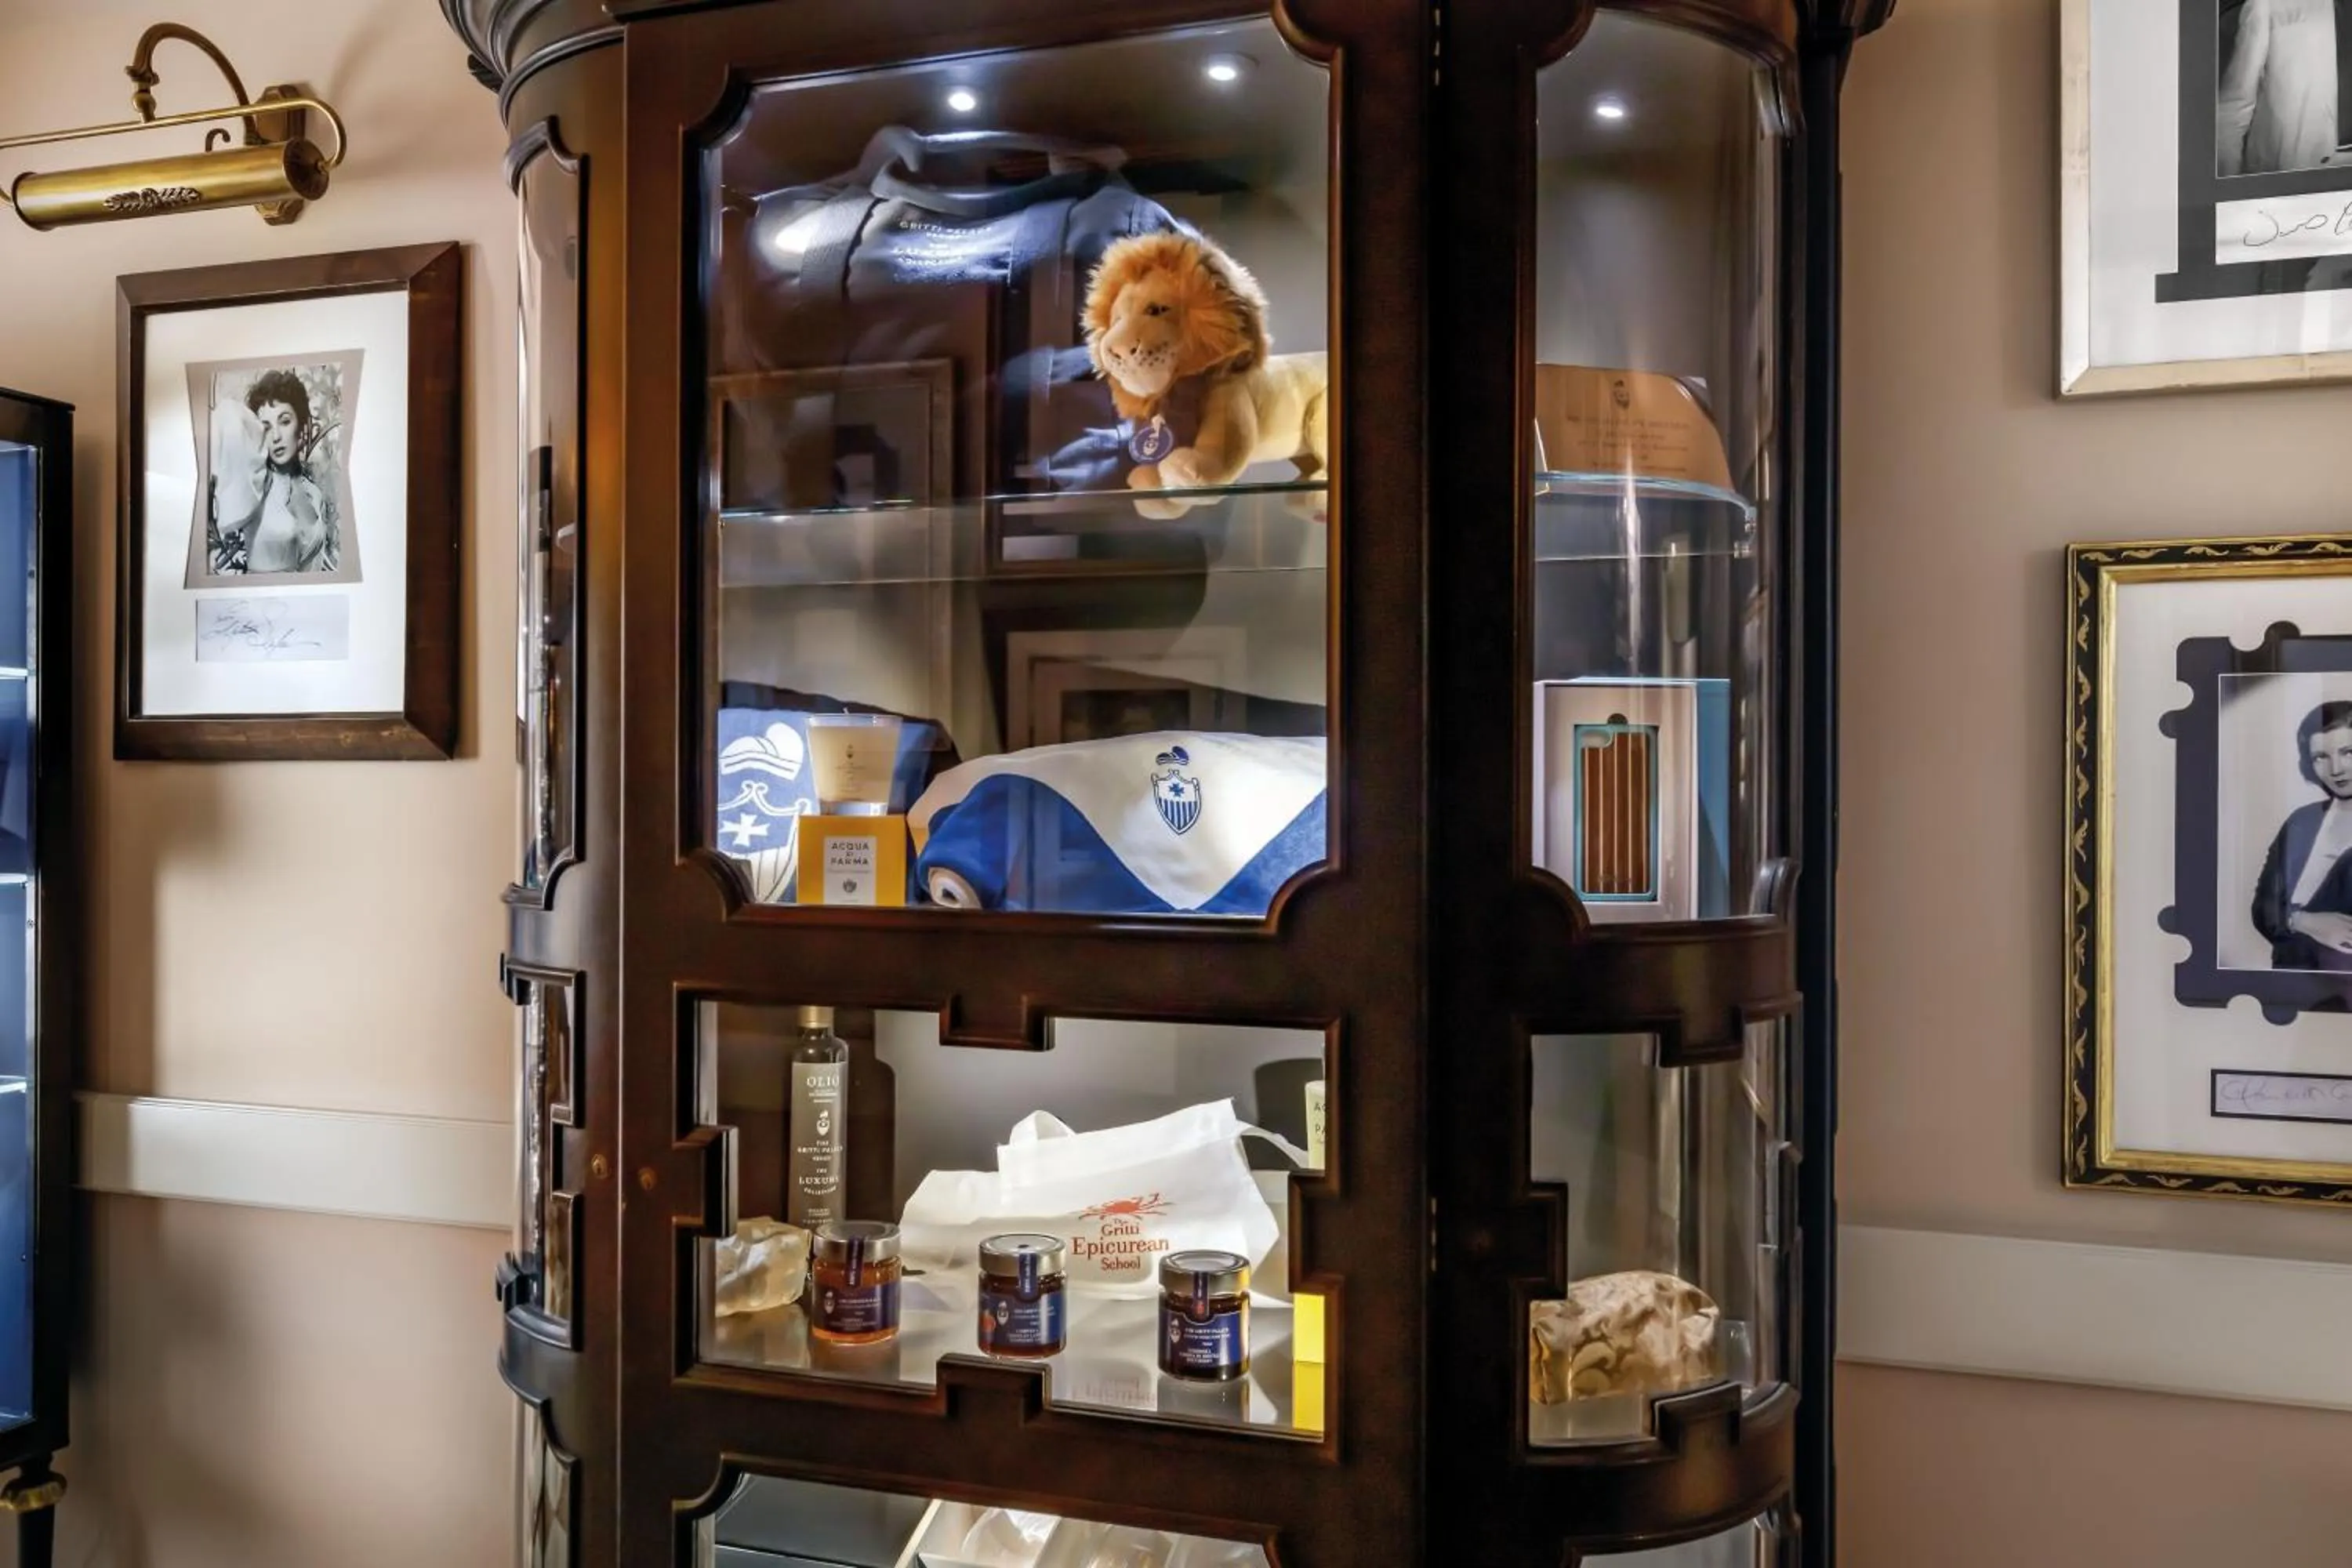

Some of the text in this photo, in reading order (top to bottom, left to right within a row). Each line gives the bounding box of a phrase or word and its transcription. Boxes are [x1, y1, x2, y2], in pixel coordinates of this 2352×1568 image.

[806, 1076, 840, 1088] OLIO
[1101, 1223, 1140, 1236] Gritti
[1071, 1236, 1170, 1261] Epicurean
[1101, 1256, 1141, 1270] School
